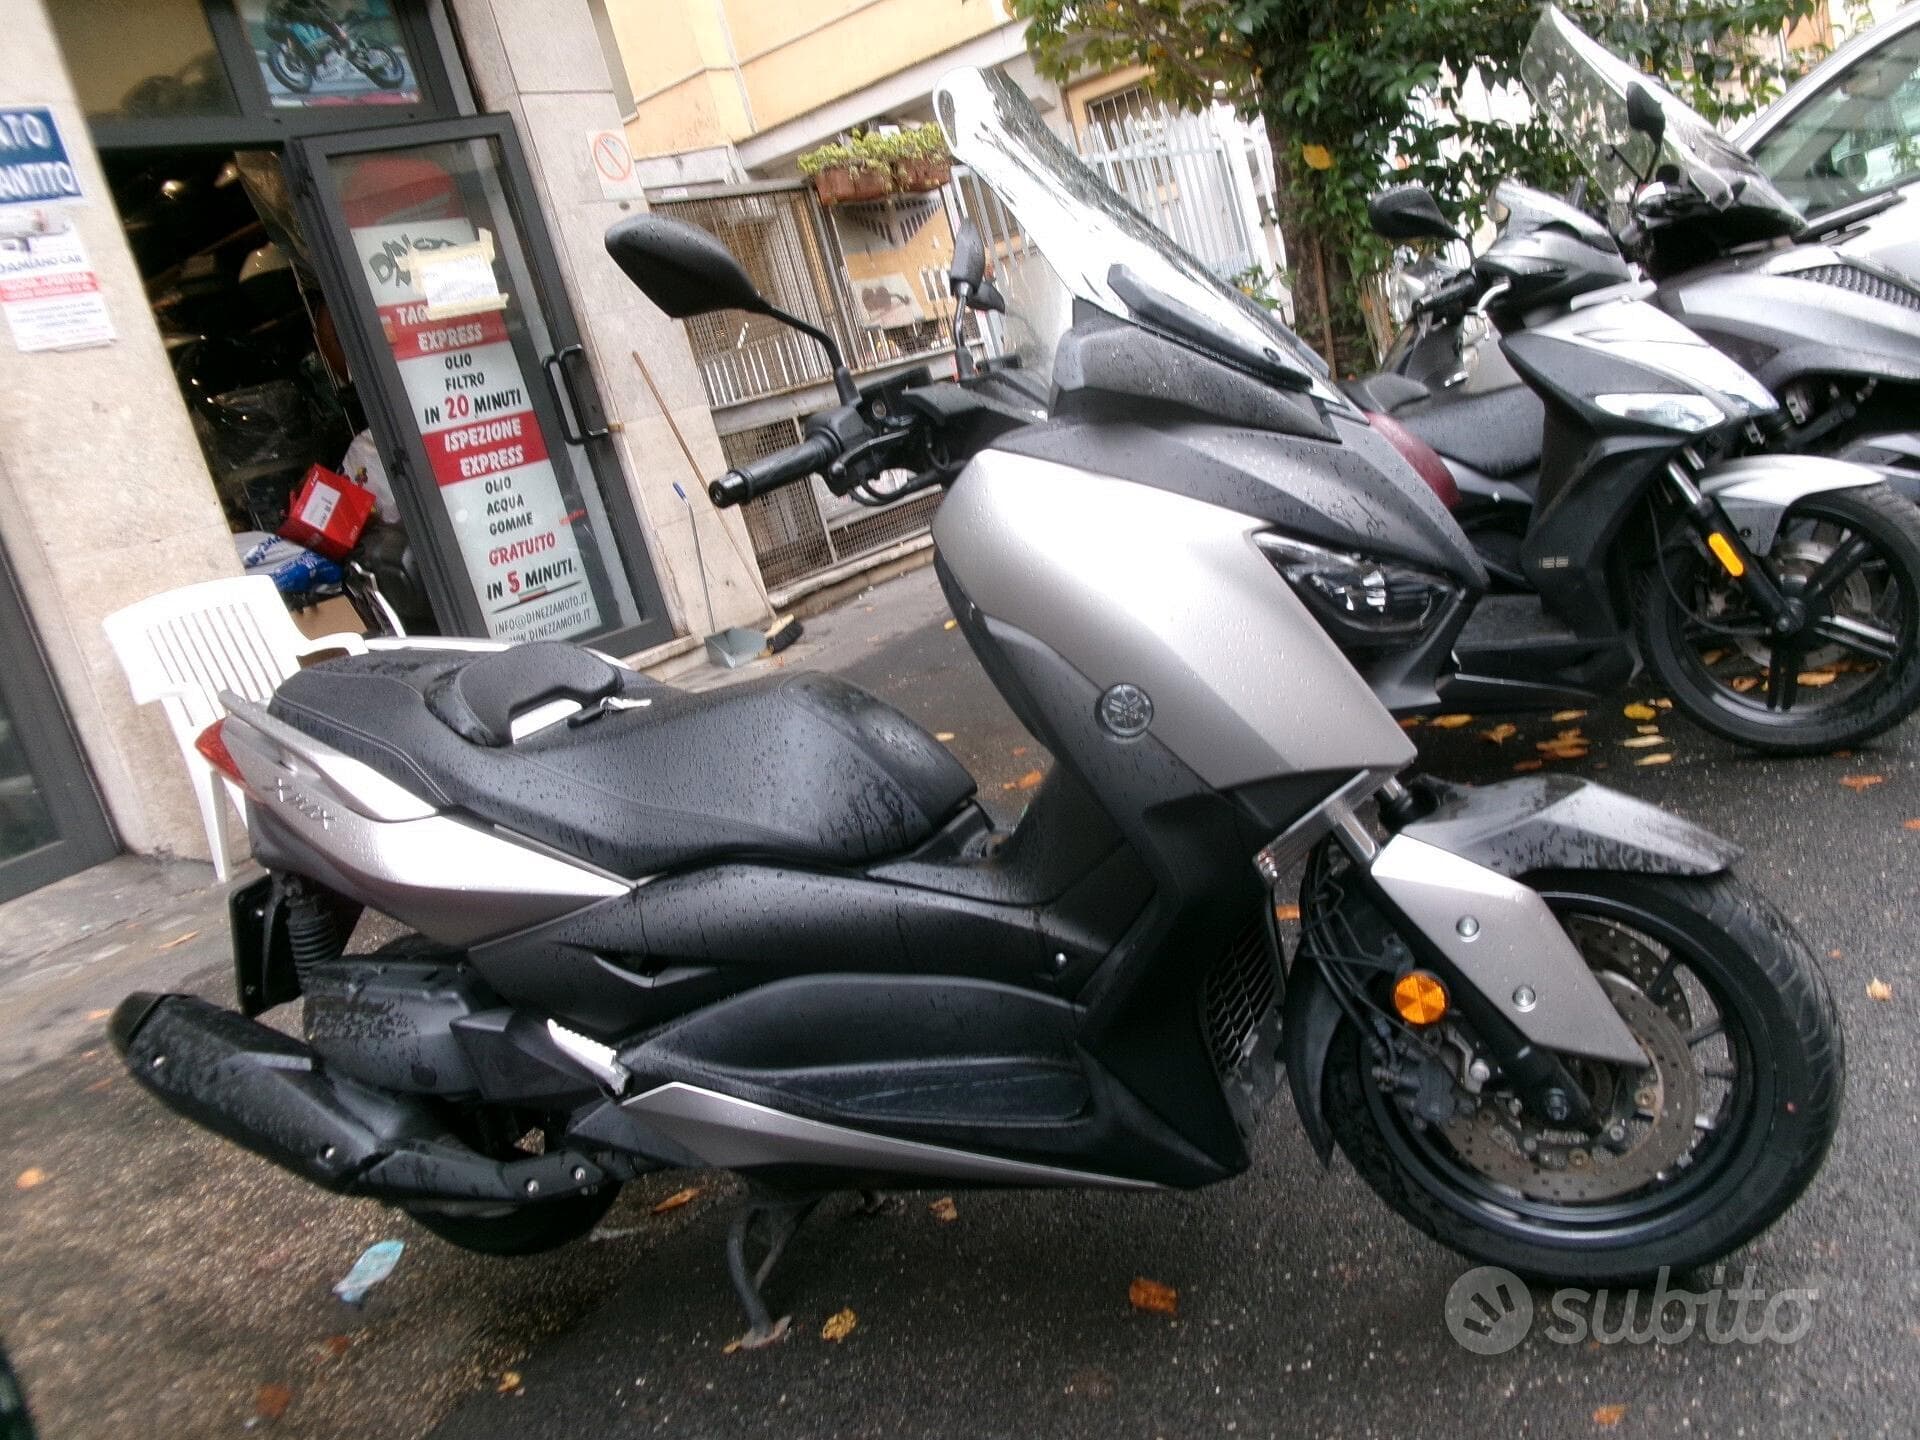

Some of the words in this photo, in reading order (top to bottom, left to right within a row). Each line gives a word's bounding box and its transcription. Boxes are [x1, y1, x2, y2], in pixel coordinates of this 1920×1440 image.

[396, 304, 430, 327] TAG
[417, 323, 483, 352] EXPRESS
[445, 353, 472, 370] OLIO
[445, 371, 485, 392] FILTRO
[424, 407, 440, 424] IN
[445, 394, 469, 420] 20
[474, 388, 522, 414] MINUTI
[444, 418, 522, 453] ISPEZIONE
[460, 445, 524, 477] EXPRESS
[485, 477, 512, 494] OLIO
[487, 494, 524, 516] ACQUA
[489, 512, 533, 536] GOMME
[488, 531, 556, 566] GRATUITO
[487, 581, 503, 600] IN
[507, 570, 520, 594] 5
[495, 592, 588, 636] INFO@DINEZZAMOTO.IT
[509, 608, 591, 641] WW.DINEZZAMOTO.IT
